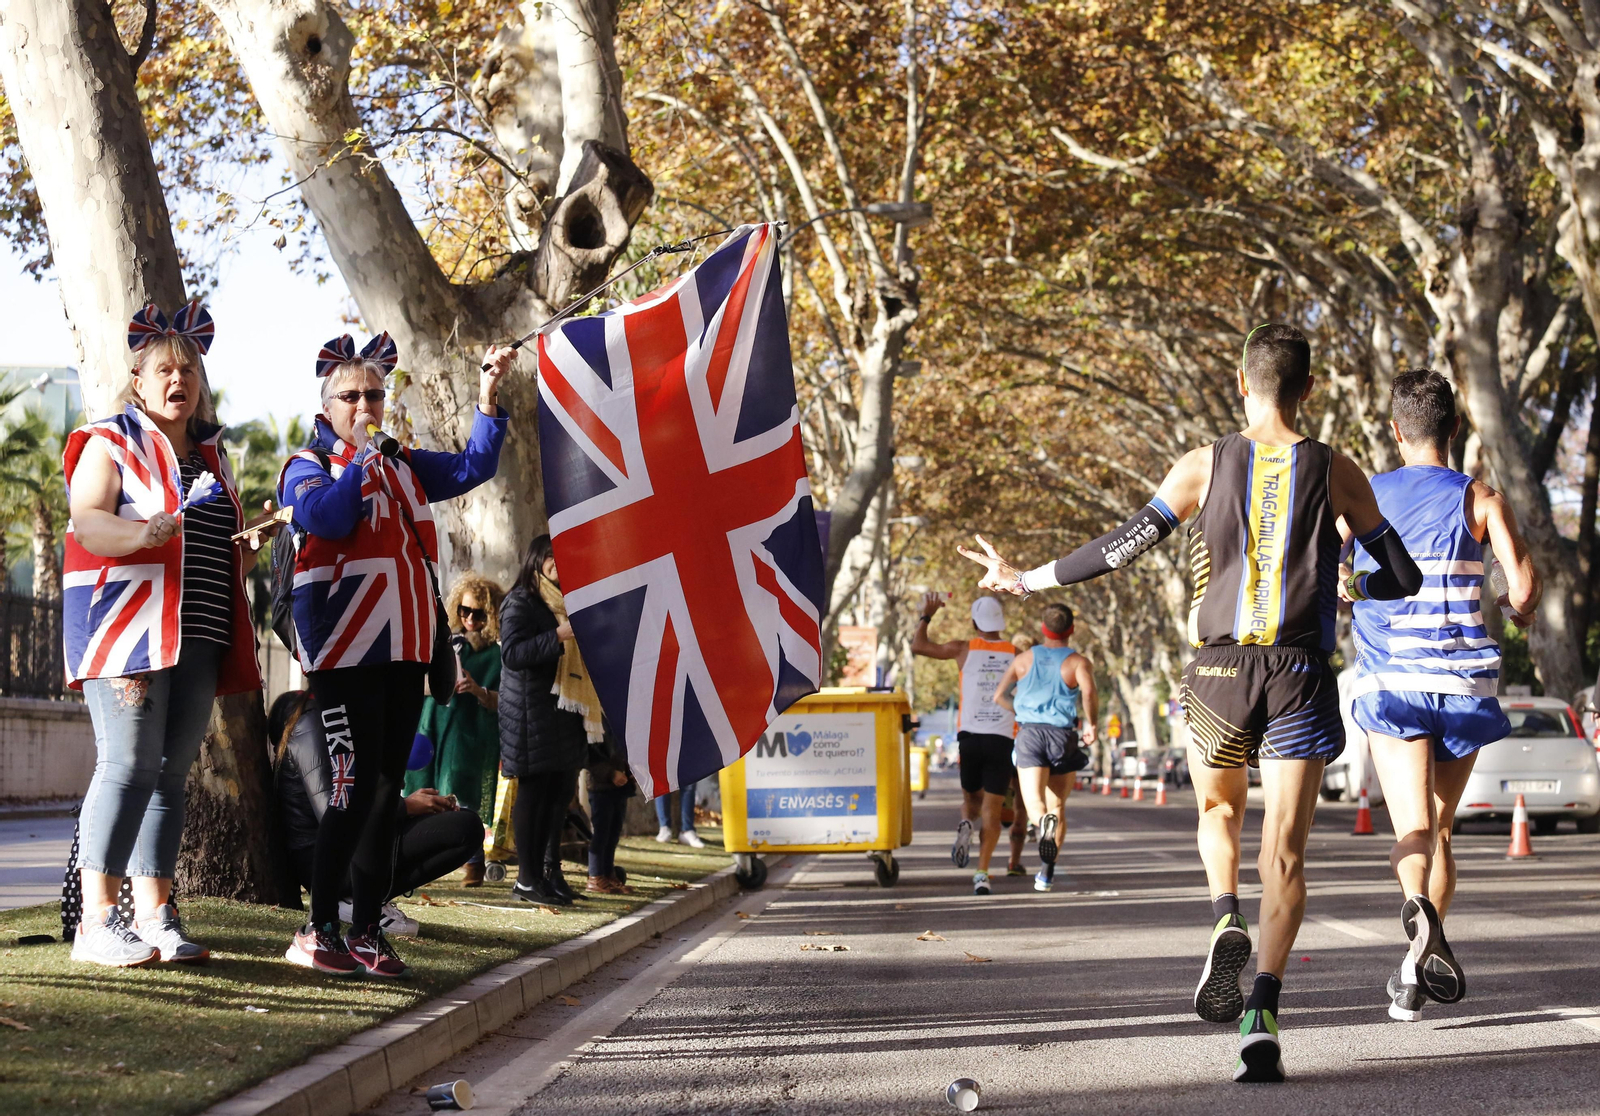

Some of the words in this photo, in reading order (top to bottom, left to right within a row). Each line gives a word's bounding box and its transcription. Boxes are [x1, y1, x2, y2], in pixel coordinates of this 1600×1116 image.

[1256, 473, 1279, 573] TRAGAMILLAS
[321, 704, 355, 755] UK
[813, 730, 849, 741] Málaga
[813, 739, 841, 749] cómo
[813, 750, 823, 758] te
[766, 769, 792, 777] evento
